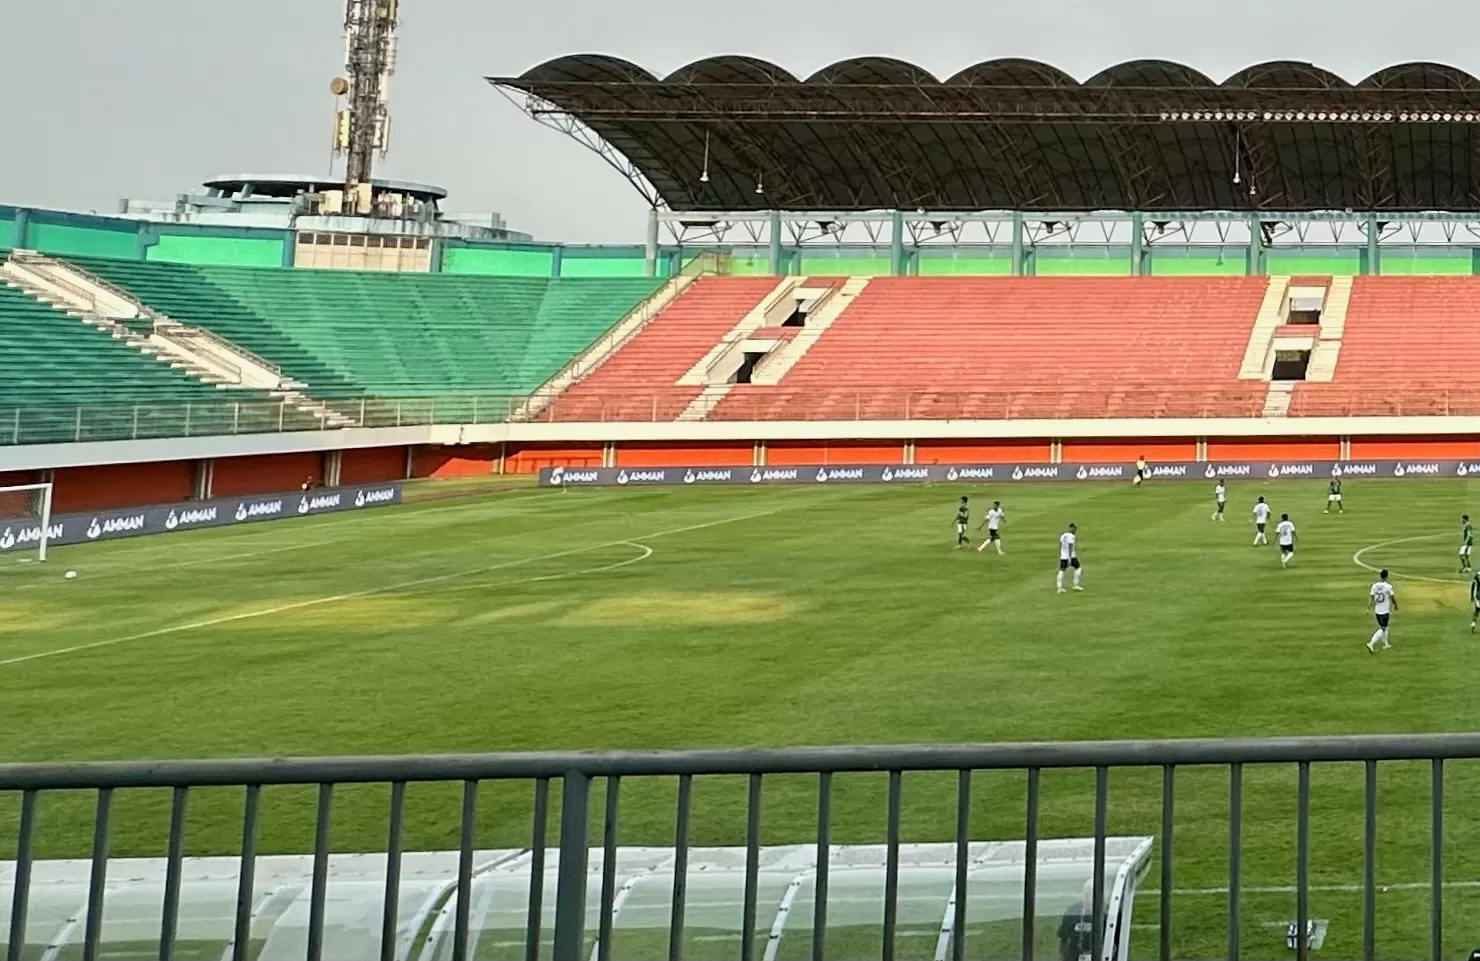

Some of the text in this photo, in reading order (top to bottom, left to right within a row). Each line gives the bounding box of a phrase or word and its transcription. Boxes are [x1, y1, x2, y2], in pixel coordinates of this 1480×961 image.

[828, 468, 863, 479] AMMAN
[894, 468, 929, 479] AMMAN
[959, 467, 994, 478] AMMAN
[1024, 466, 1058, 477] AMMAN
[1088, 466, 1123, 477] AMMAN
[1152, 465, 1186, 476] AMMAN
[1216, 465, 1250, 475] AMMAN
[1280, 464, 1313, 475] AMMAN
[1343, 464, 1376, 474] AMMAN
[1406, 463, 1439, 474] AMMAN
[562, 471, 598, 482] AMMAN
[629, 470, 665, 481] AMMAN
[696, 469, 732, 481] AMMAN
[762, 469, 798, 480] AMMAN
[365, 488, 394, 502] AMMAN
[309, 494, 341, 509] AMMAN
[248, 500, 282, 516] AMMAN
[179, 507, 217, 524] AMMAN
[102, 514, 144, 533] AMMAN
